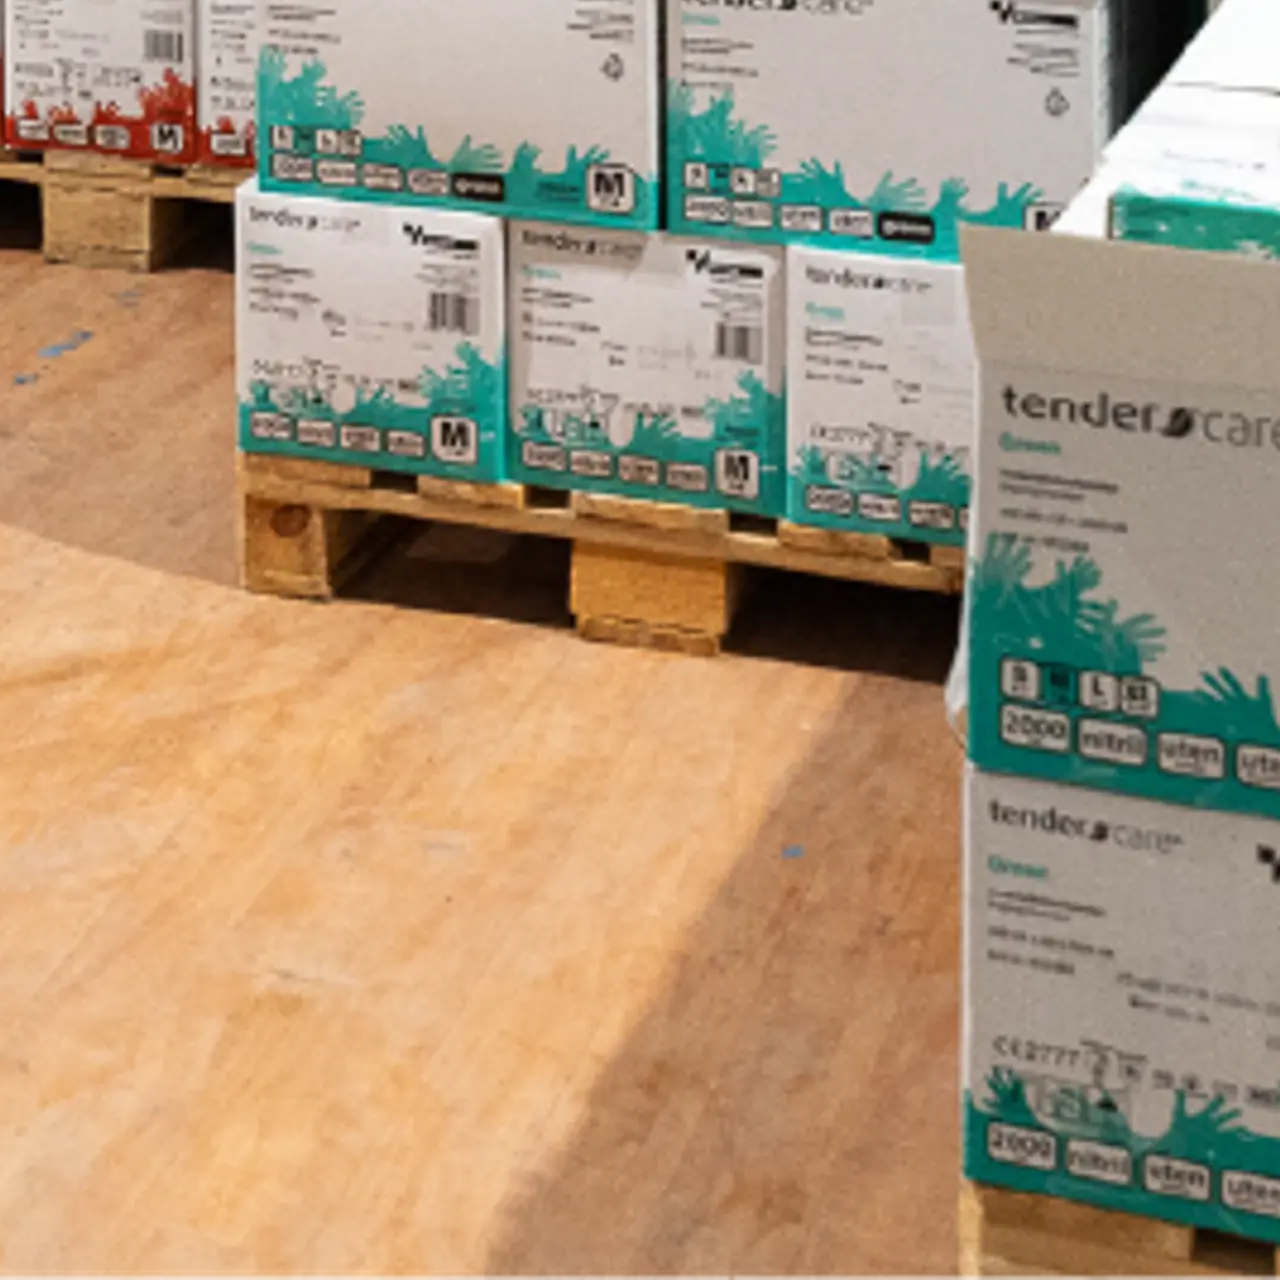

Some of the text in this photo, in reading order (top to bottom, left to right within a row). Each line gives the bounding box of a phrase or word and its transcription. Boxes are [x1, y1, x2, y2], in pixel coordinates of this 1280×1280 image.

[595, 172, 624, 196] M
[1002, 386, 1153, 432] tender
[441, 422, 468, 447] M
[1006, 711, 1068, 739] 2000
[989, 800, 1085, 835] tender
